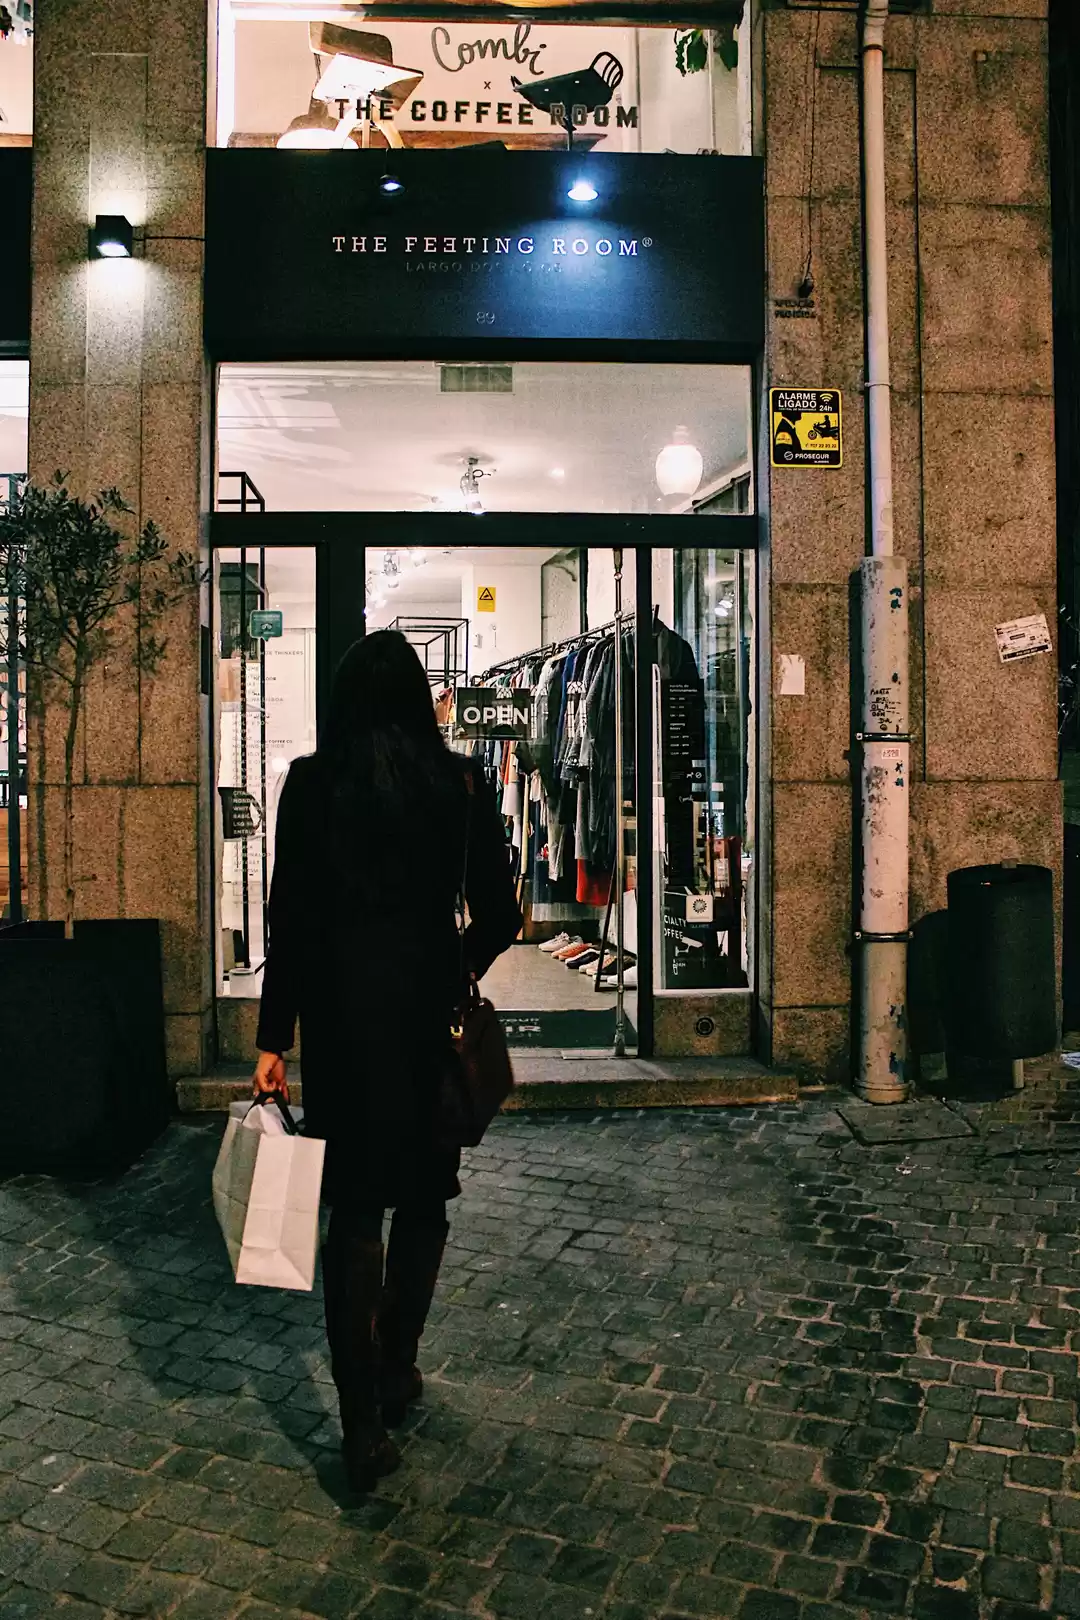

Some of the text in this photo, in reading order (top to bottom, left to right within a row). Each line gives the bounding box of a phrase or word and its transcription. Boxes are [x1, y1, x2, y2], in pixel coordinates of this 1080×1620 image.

[431, 20, 547, 75] Combi
[334, 98, 638, 128] THE COFFEE ROOM
[333, 236, 387, 252] THE
[406, 262, 462, 273] LARGO
[476, 311, 496, 325] 89
[778, 392, 817, 401] ALARME
[778, 400, 817, 408] LIGADO
[463, 706, 528, 725] OPEN
